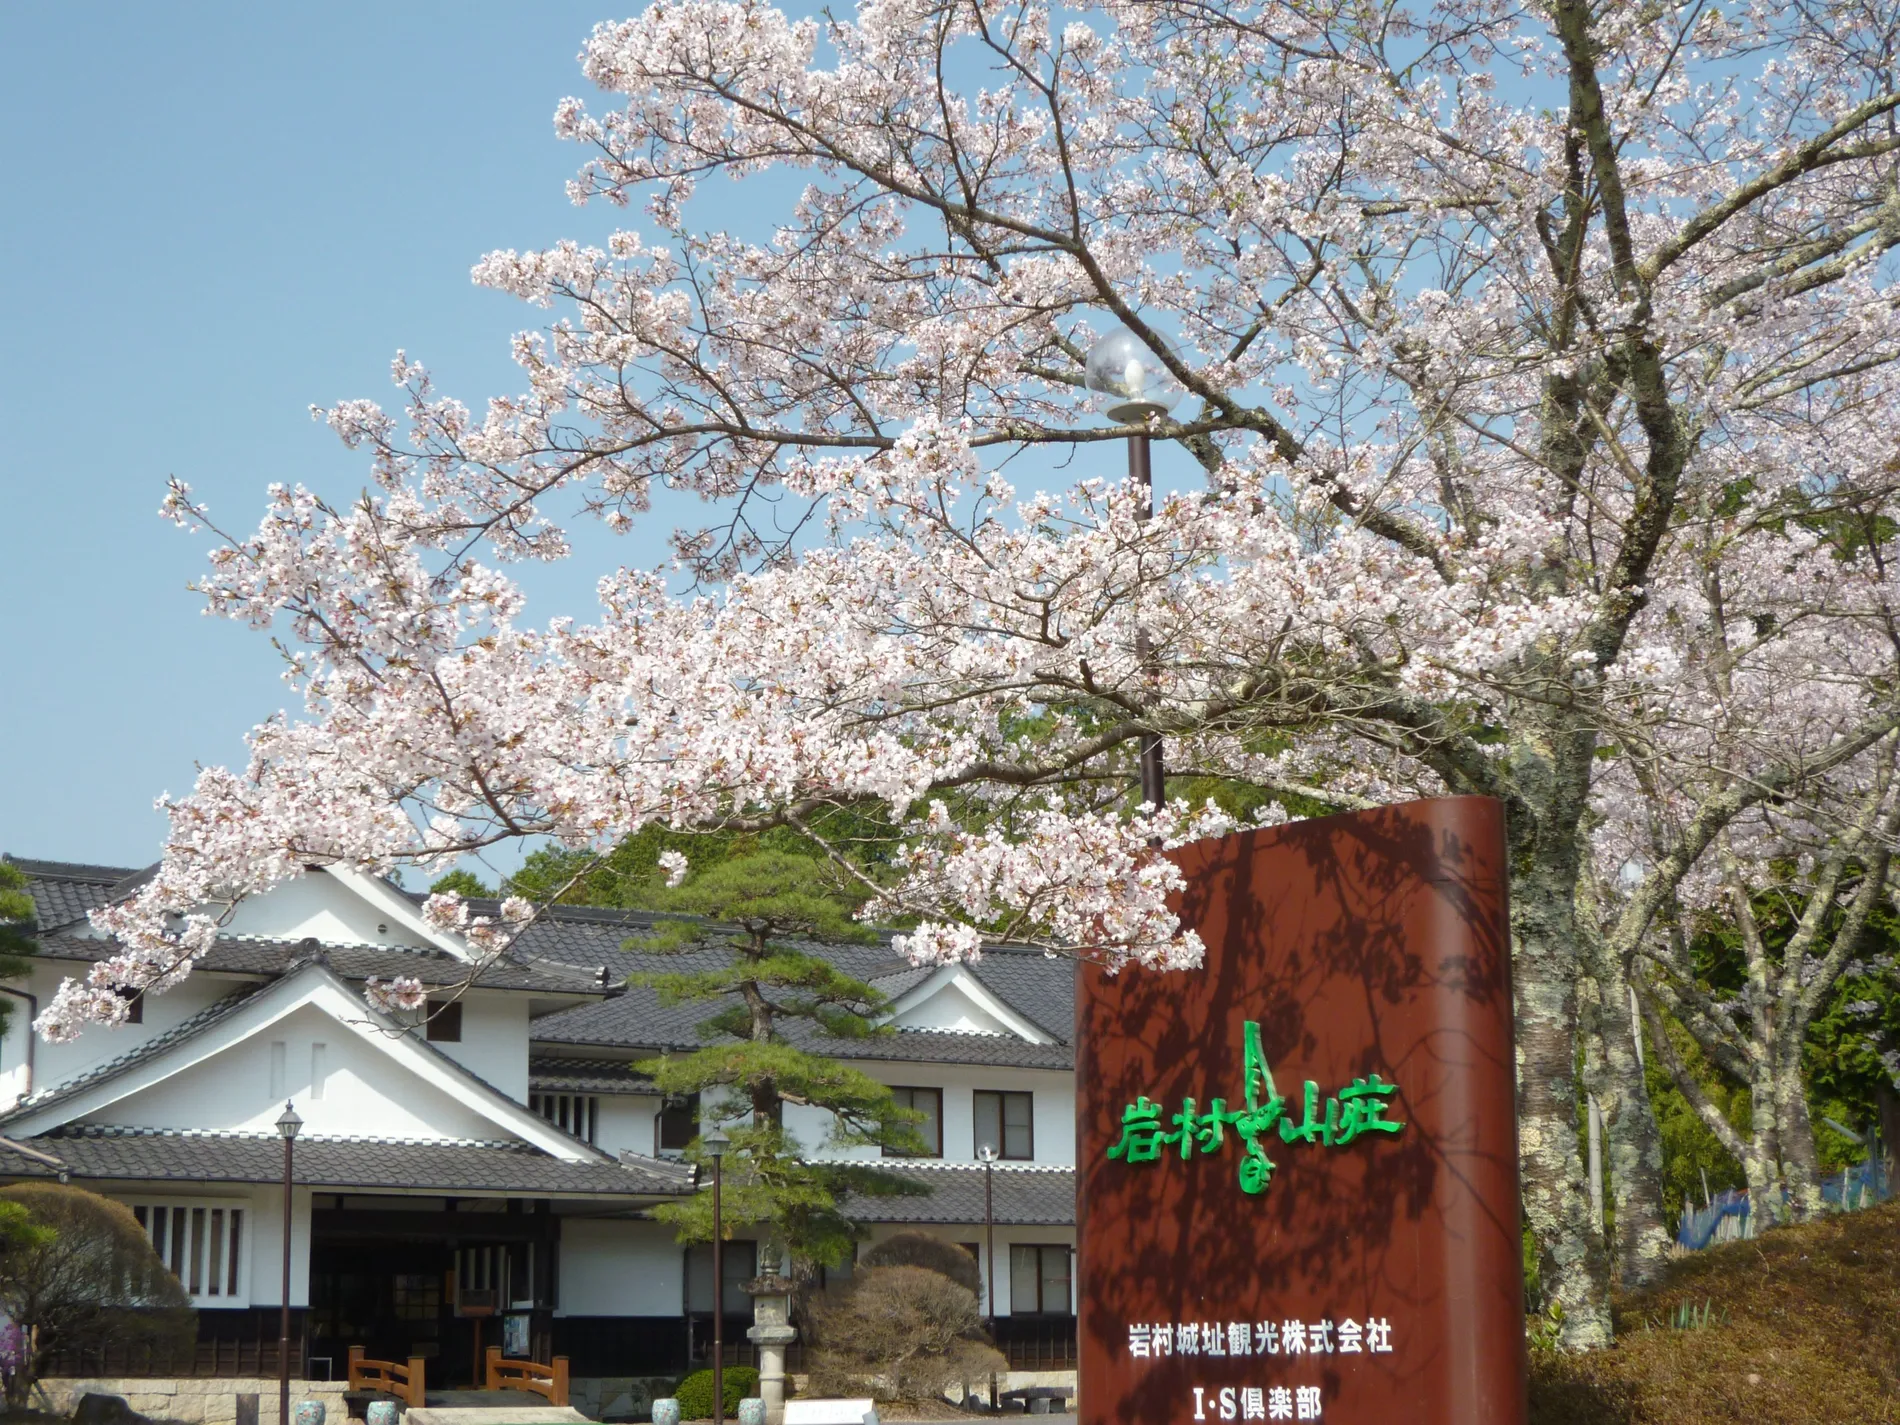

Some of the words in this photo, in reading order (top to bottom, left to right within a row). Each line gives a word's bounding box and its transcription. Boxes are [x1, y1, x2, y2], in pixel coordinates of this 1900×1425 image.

[1129, 1318, 1393, 1357] 岩村城址観光株式会社
